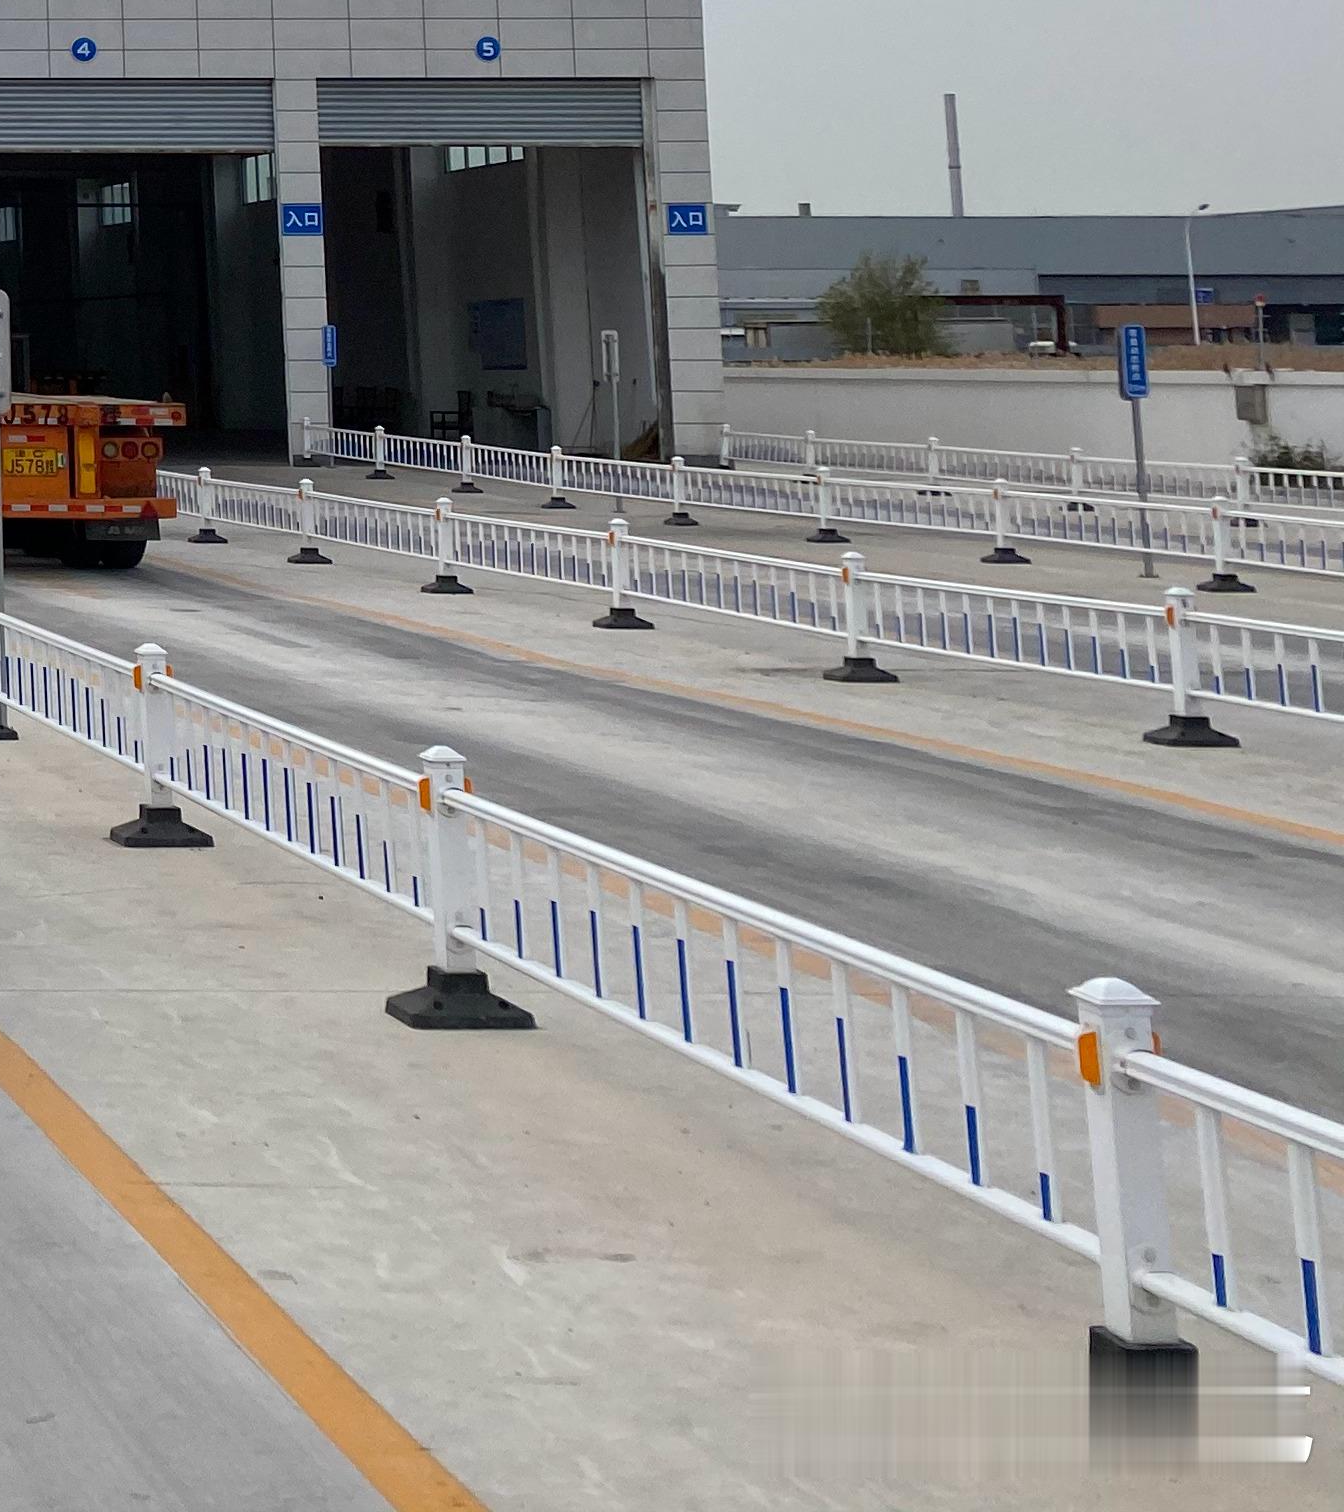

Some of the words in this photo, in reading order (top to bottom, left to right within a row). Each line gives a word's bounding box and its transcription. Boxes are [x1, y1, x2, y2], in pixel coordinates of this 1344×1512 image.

[76, 42, 91, 56] 4
[482, 42, 495, 57] 5
[286, 211, 318, 227] 入口
[671, 211, 703, 227] 入口
